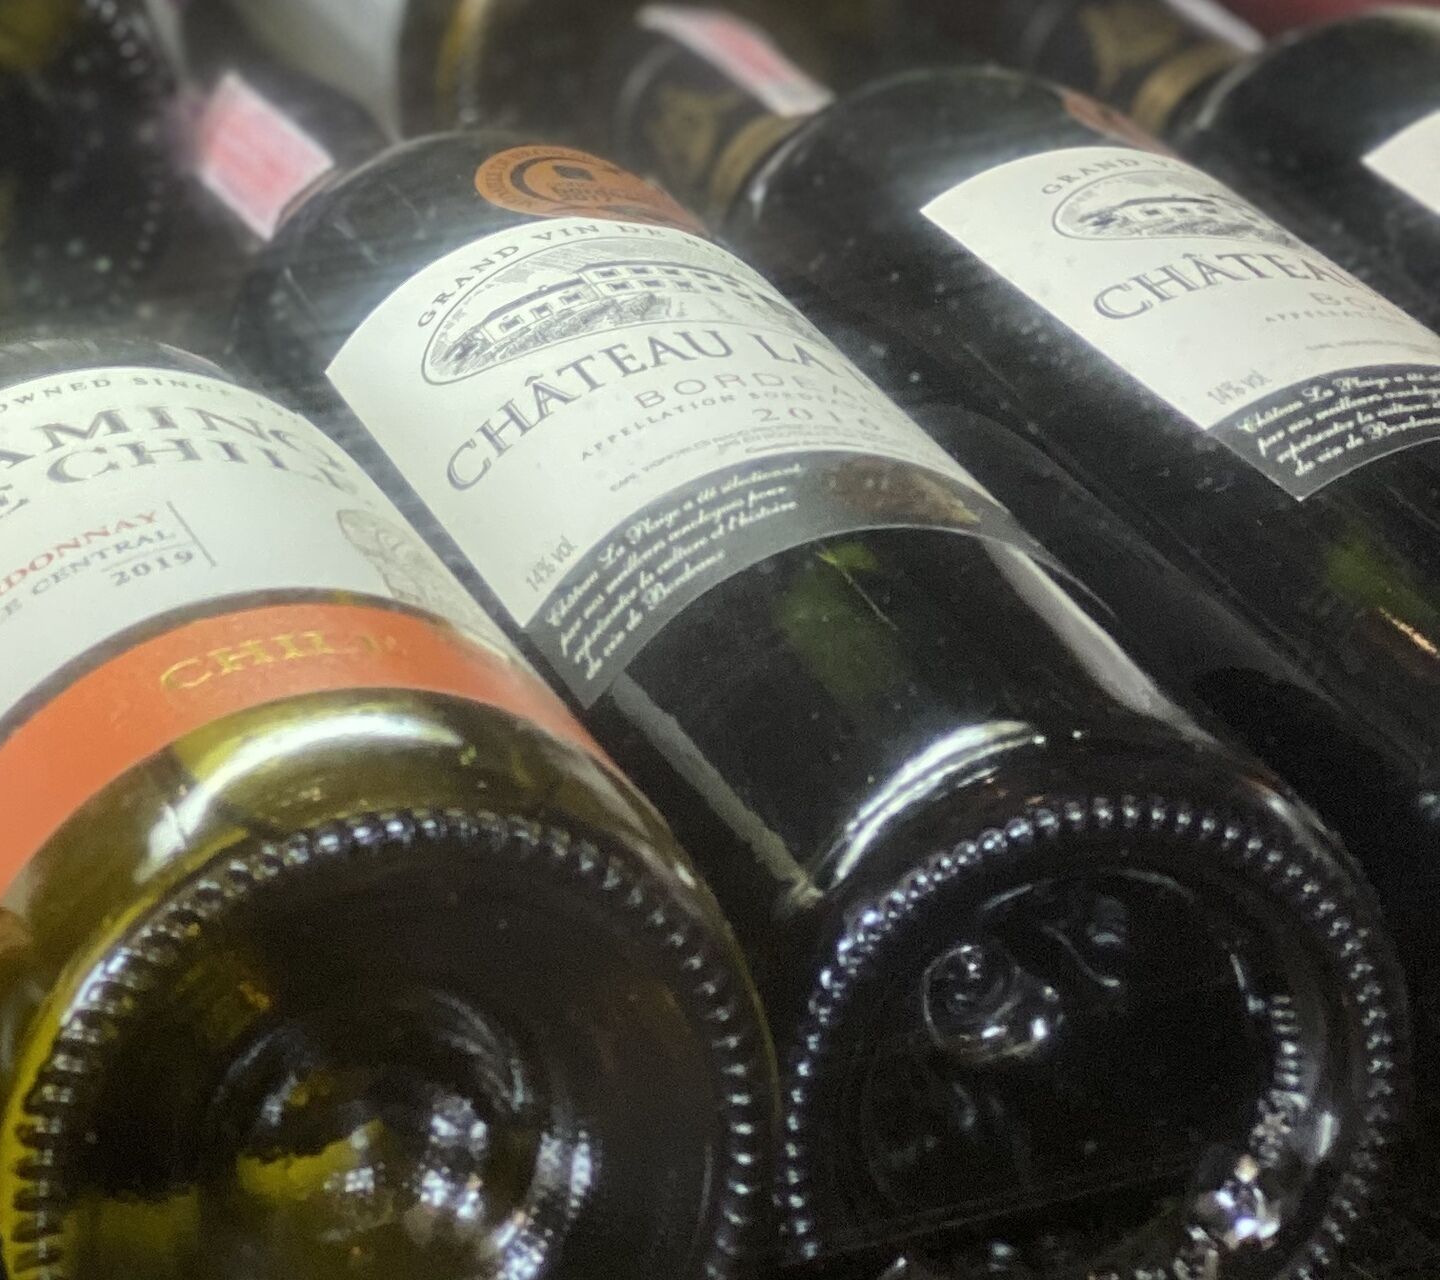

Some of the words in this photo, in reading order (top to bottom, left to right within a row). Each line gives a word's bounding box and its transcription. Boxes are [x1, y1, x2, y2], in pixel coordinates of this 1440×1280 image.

[1042, 158, 1139, 195] GRAND
[417, 244, 520, 328] GRAND
[531, 223, 600, 241] VIN
[446, 329, 734, 491] CHÂTEAU
[581, 394, 736, 462] APPELLATION
[1362, 415, 1440, 440] Bordea
[30, 529, 177, 596] CENTRAL
[109, 549, 194, 588] 2019
